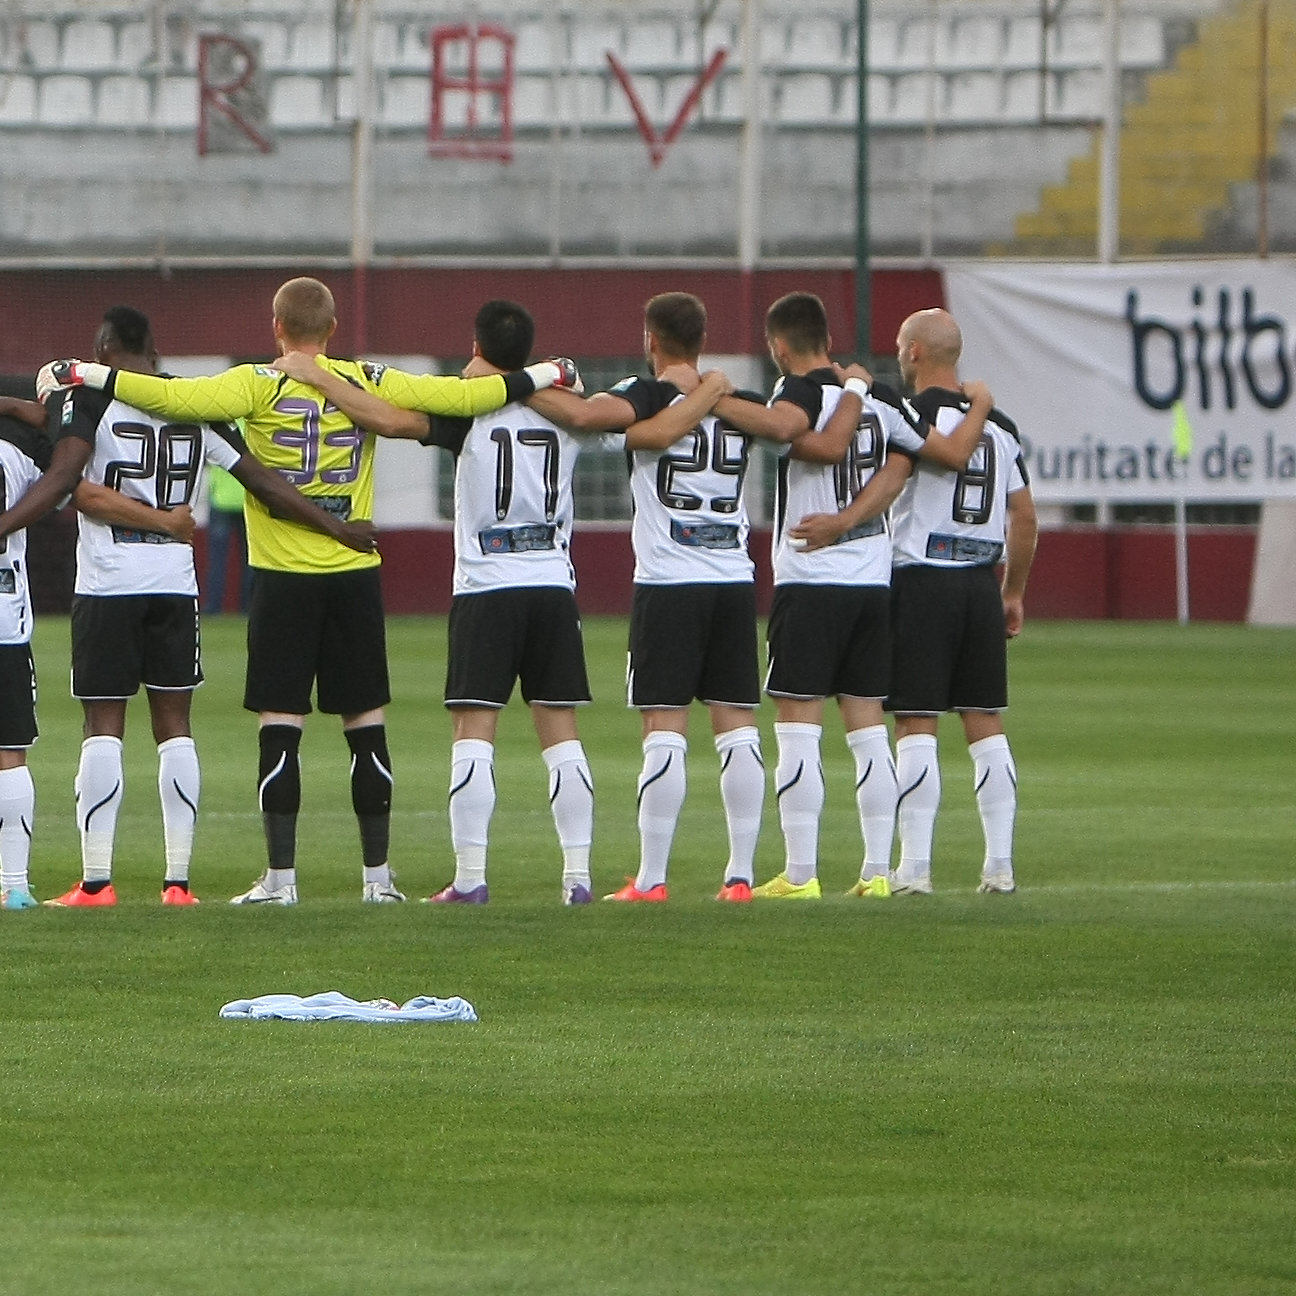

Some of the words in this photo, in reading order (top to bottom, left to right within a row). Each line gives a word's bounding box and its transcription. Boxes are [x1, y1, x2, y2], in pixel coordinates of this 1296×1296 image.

[1126, 286, 1296, 411] bilb
[105, 422, 203, 510] 28
[272, 397, 368, 485] 33
[490, 426, 560, 522] 17
[656, 418, 749, 512] 29
[951, 432, 996, 526] 8
[1201, 429, 1253, 480] de
